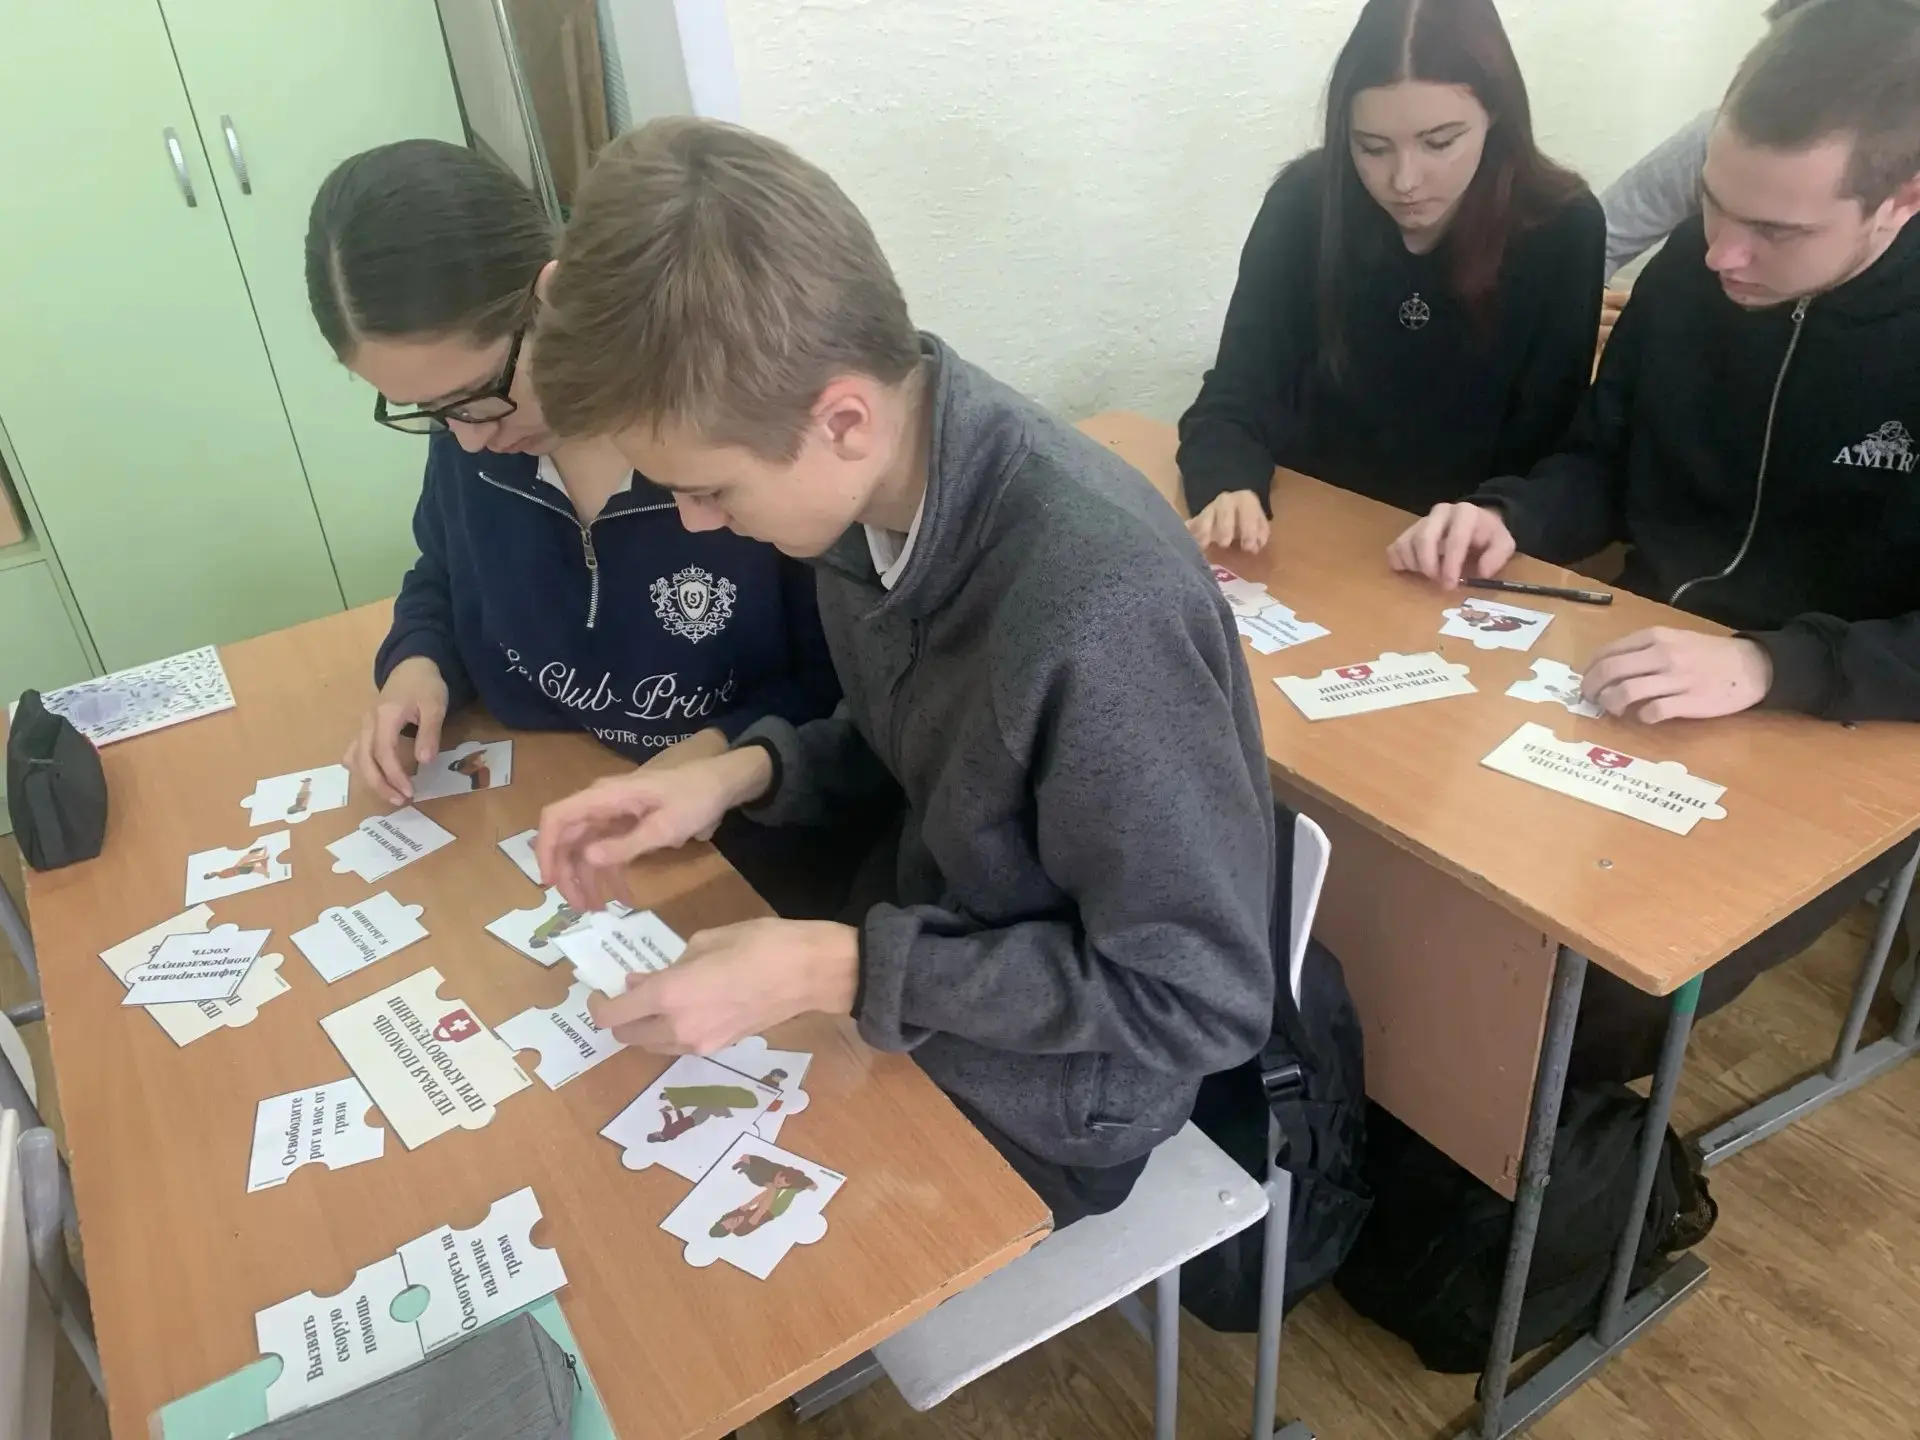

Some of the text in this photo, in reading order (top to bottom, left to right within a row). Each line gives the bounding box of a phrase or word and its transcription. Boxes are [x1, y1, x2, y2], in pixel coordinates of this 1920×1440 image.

[539, 661, 621, 711] Club
[1319, 674, 1450, 703] ПЕРВАЯ ПОМОЩЬ
[1404, 667, 1436, 679] ПРИ
[593, 727, 638, 744] VOTRE
[1528, 754, 1684, 814] ПЕРВАЯ ПОМОЩЬ
[1599, 768, 1664, 794] ЗАВАЛЕ
[1668, 790, 1707, 810] ПРИ
[137, 967, 246, 983] Зафиксировать
[147, 955, 251, 970] поврежденную
[192, 946, 230, 955] кость
[386, 996, 487, 1113] ПРИ КРОВОТЕЧЕНИИ
[549, 1011, 598, 1059] Наложить
[372, 1014, 456, 1117] ПЕРВАЯ ПОМОЩЬ
[281, 1096, 303, 1166] Освободите
[309, 1090, 326, 1160] рот и нос от
[334, 1101, 350, 1136] грязи
[470, 1238, 500, 1298] наличие
[496, 1233, 524, 1279] травм
[440, 1232, 479, 1331] Осмотреть на
[303, 1314, 325, 1383] Вызвать
[329, 1307, 352, 1363] скорую
[355, 1294, 378, 1355] помощь
